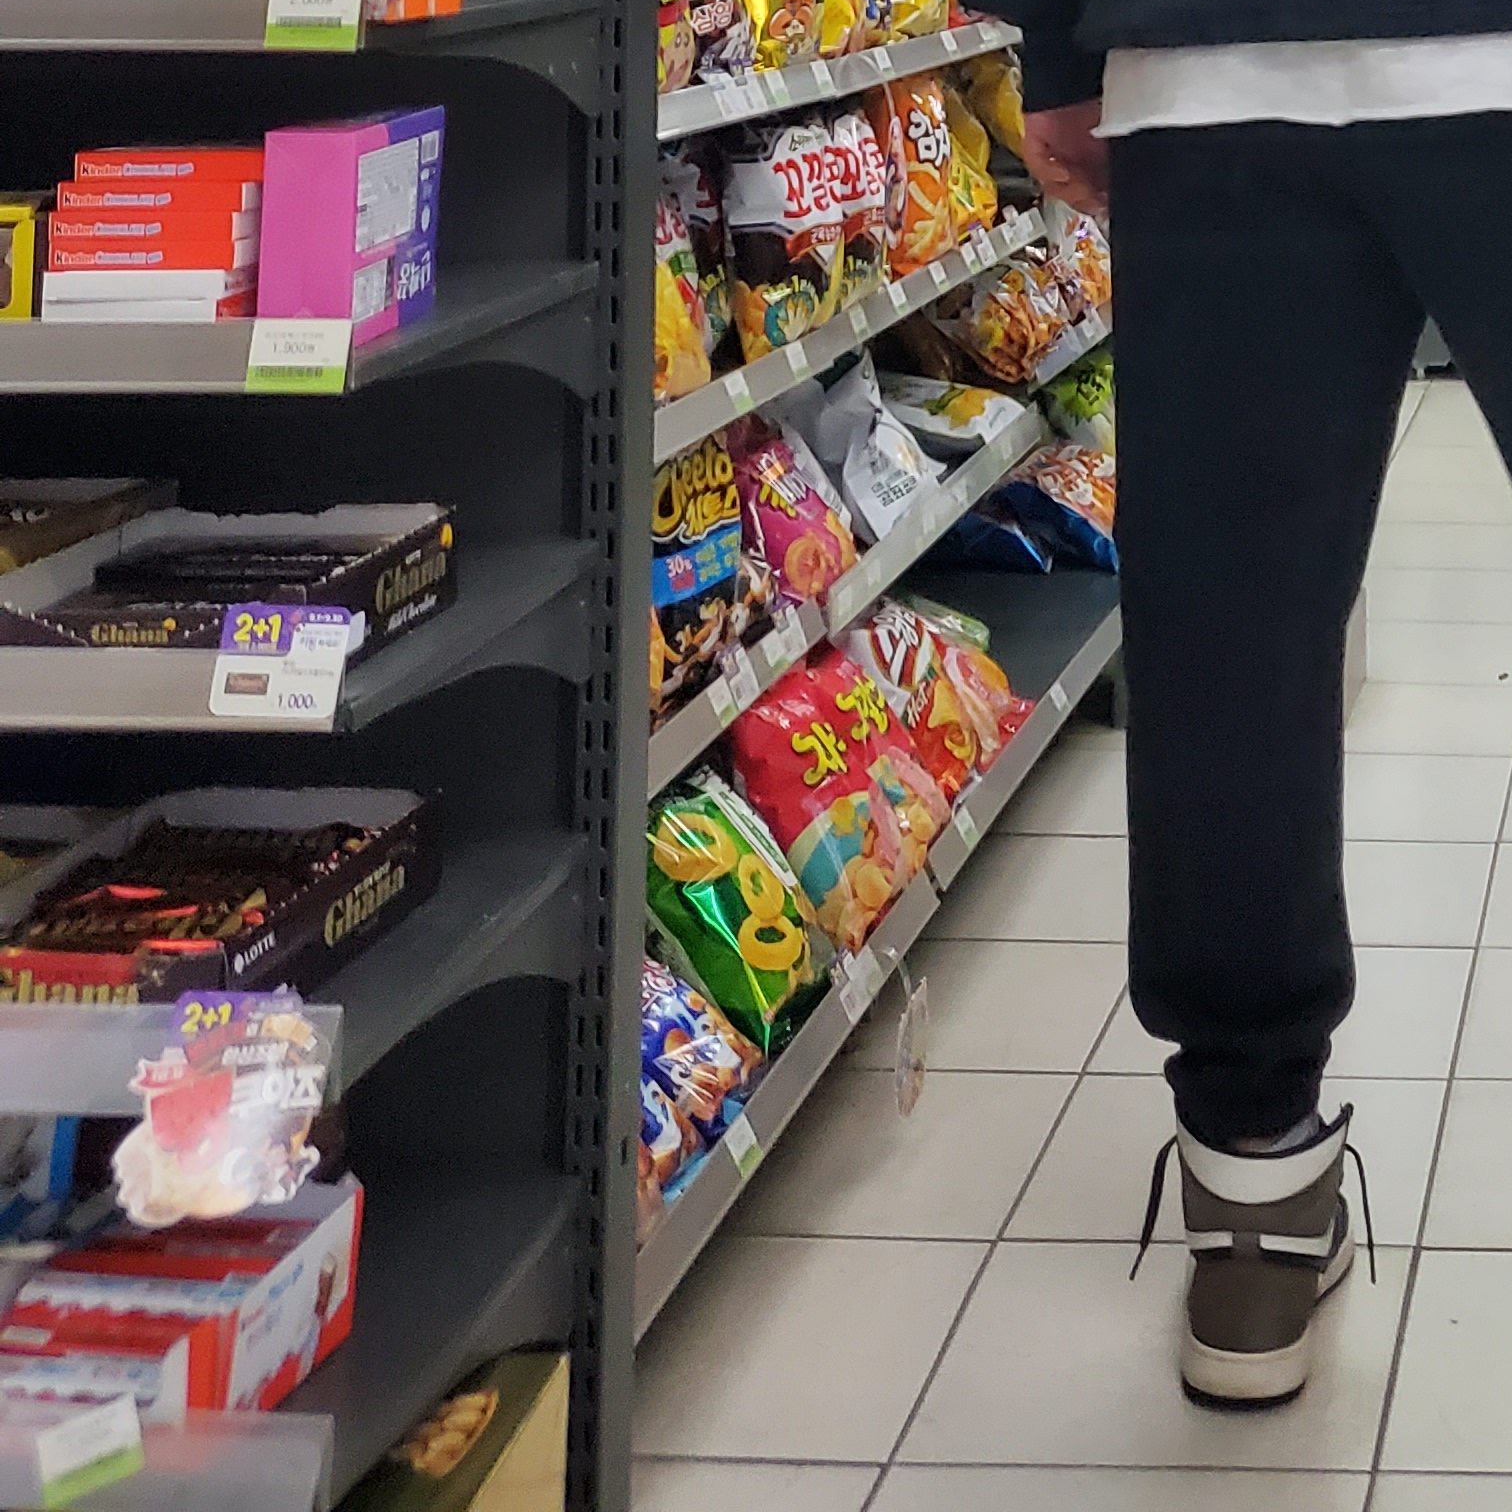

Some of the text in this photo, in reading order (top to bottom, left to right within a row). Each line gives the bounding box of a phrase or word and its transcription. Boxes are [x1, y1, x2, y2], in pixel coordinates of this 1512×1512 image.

[232, 613, 283, 643] 2+1
[243, 931, 278, 968] LOTTE
[180, 1001, 233, 1034] 2+1
